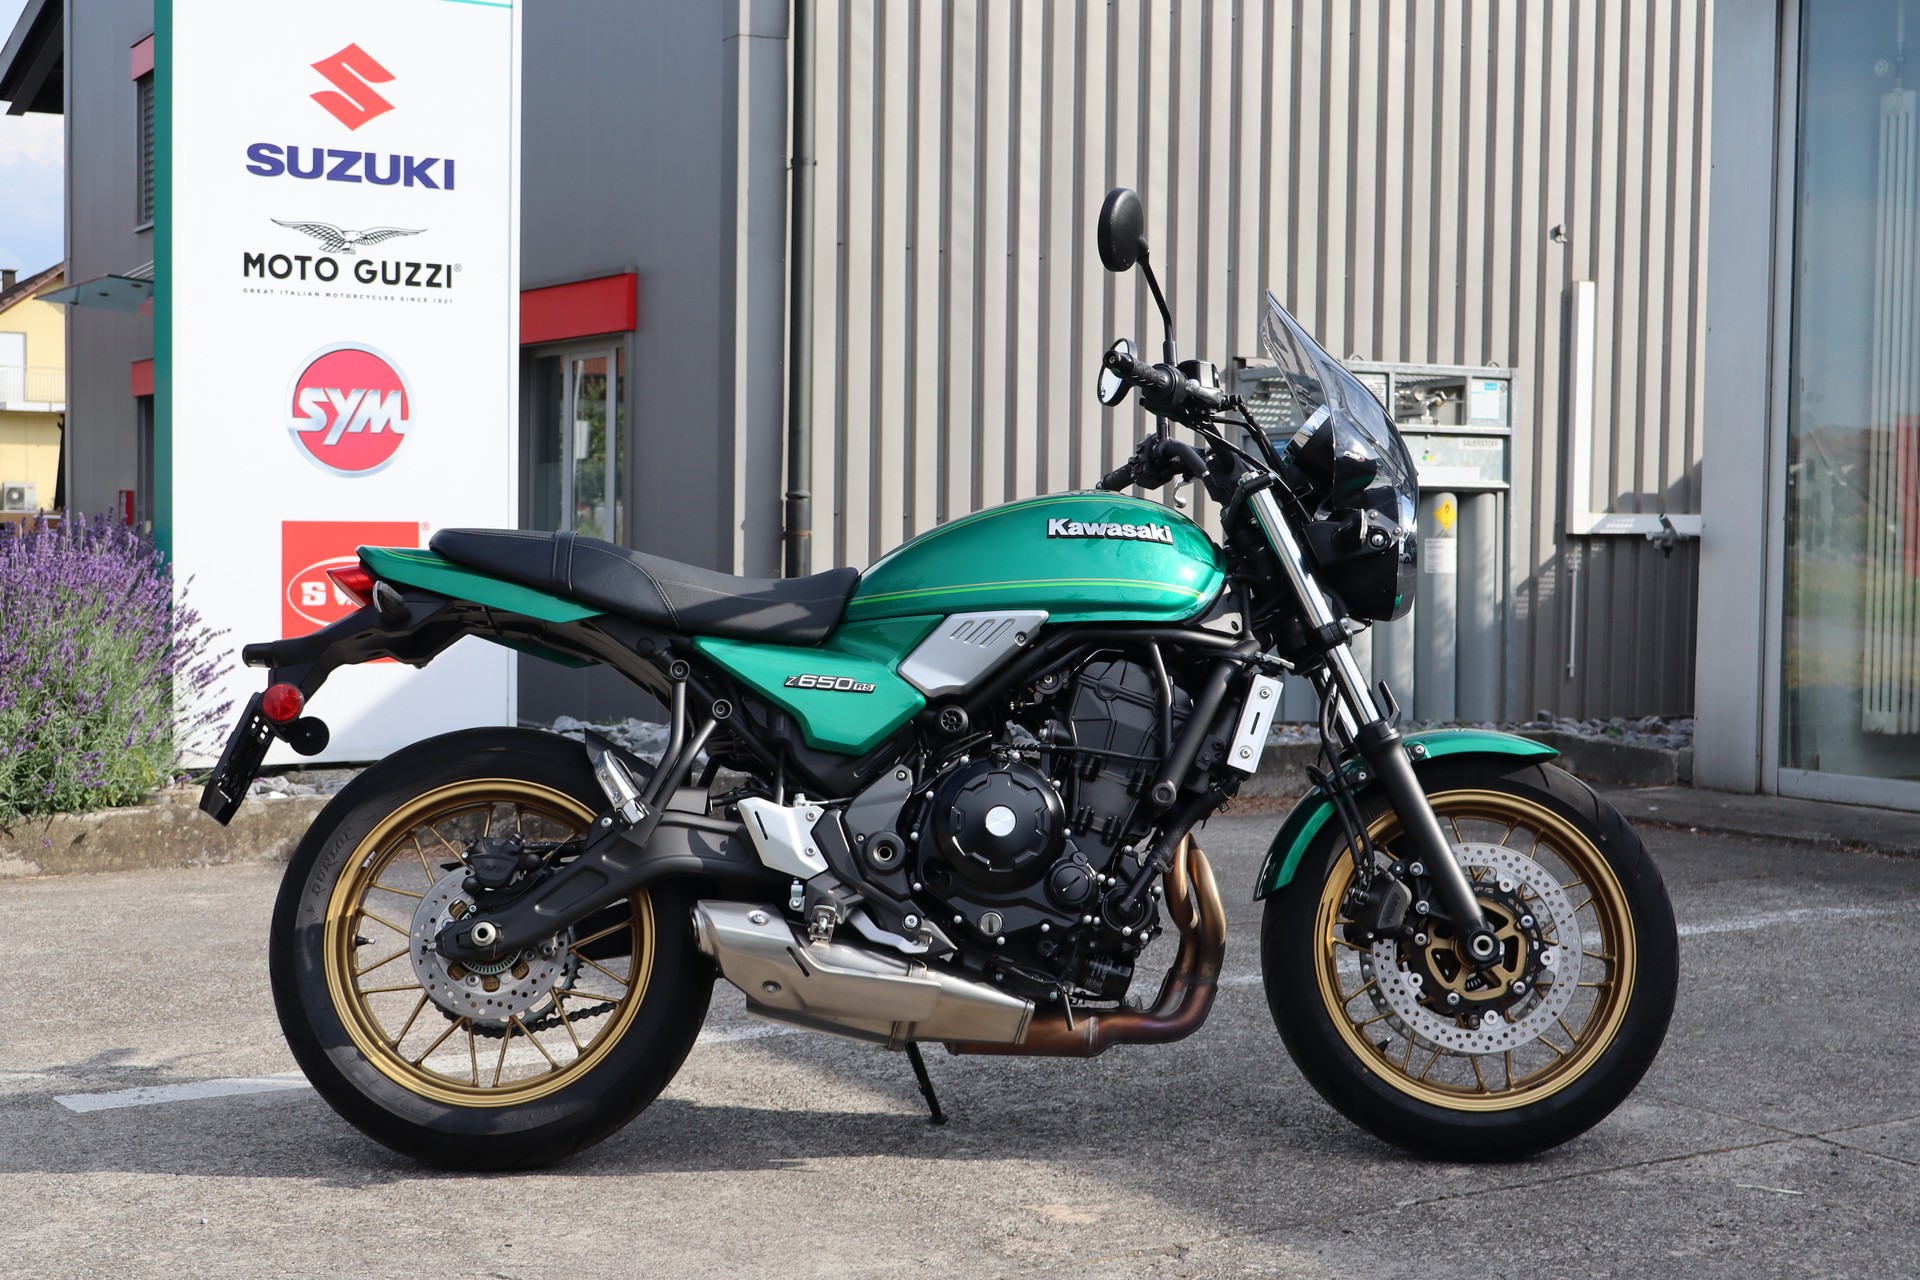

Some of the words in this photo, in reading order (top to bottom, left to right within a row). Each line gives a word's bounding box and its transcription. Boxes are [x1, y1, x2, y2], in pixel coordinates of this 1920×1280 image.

[246, 142, 455, 190] SUZUKI
[243, 252, 339, 282] MOTO
[353, 259, 452, 288] GUZZI
[242, 287, 275, 295] GREAT
[279, 289, 320, 297] ITALIAN
[325, 292, 395, 301] MOTORCYCLES
[290, 387, 408, 446] SYM
[1047, 518, 1173, 544] Kawasaki
